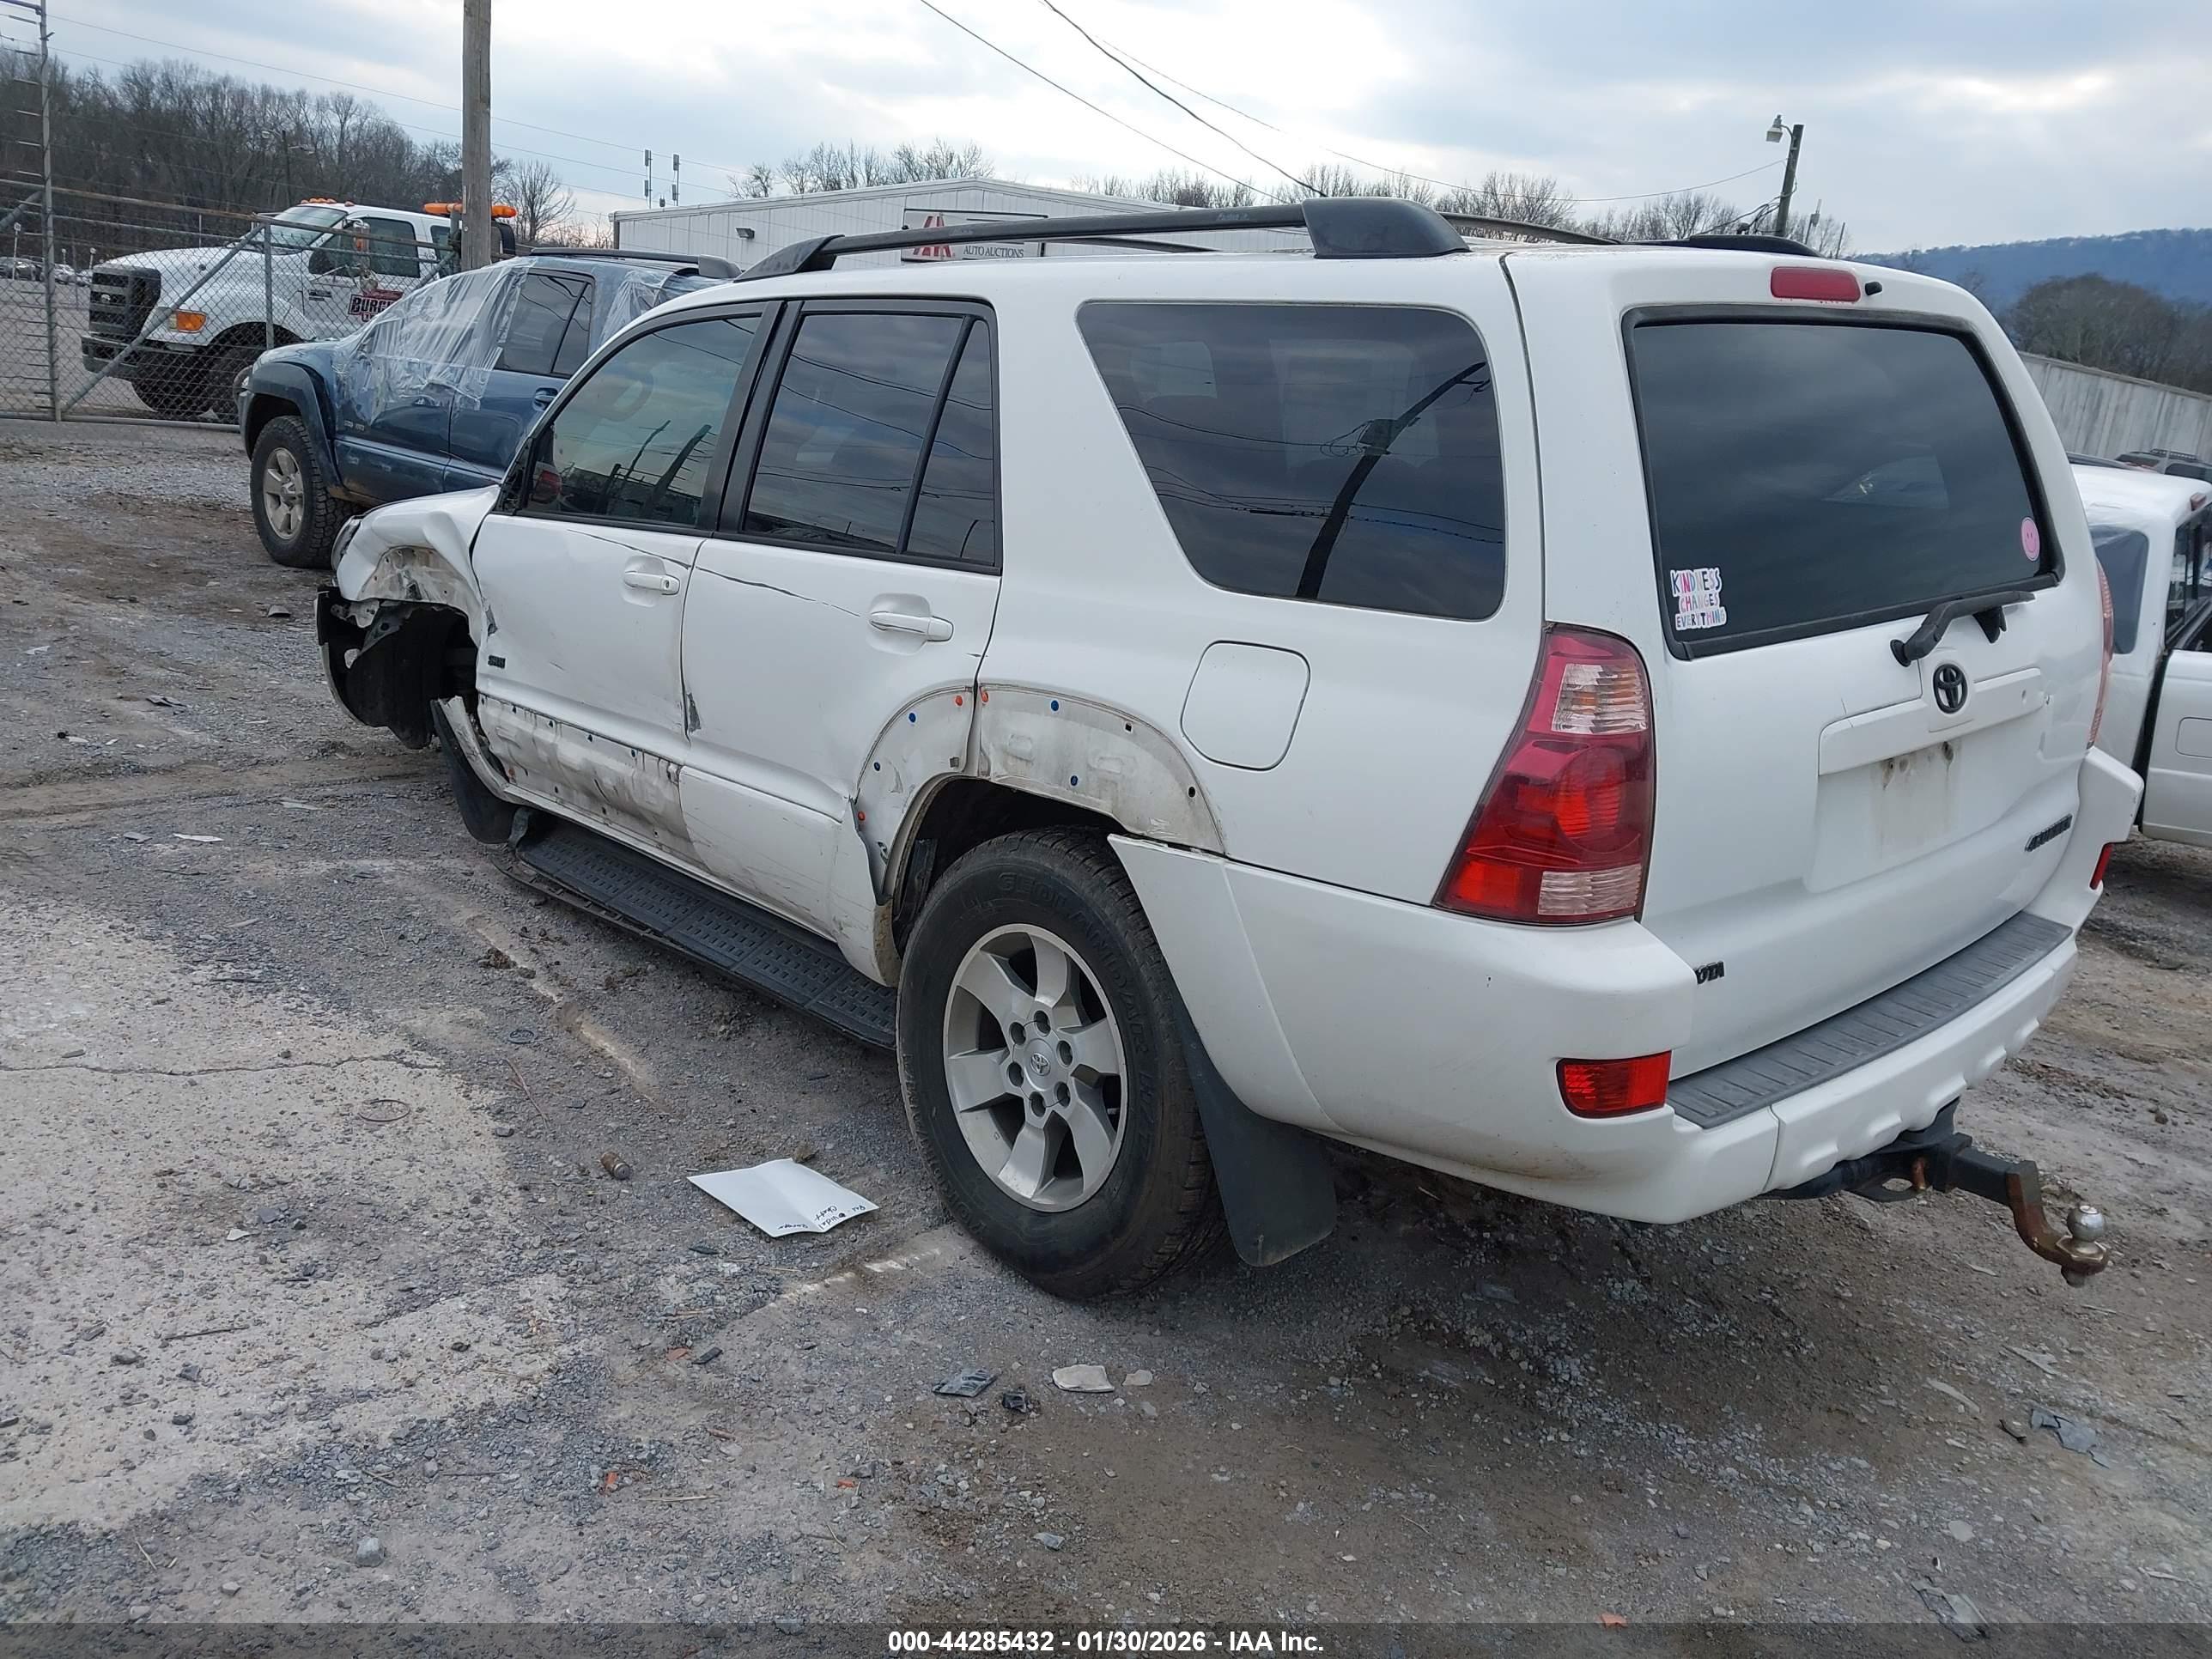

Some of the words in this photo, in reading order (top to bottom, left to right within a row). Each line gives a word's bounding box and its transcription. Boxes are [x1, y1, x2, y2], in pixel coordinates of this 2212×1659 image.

[963, 245, 985, 257] AUTO
[985, 245, 1024, 258] AUCTIONS
[1670, 569, 1720, 594] KINDNESS
[1680, 592, 1718, 612] CHANGES
[1676, 609, 1725, 628] EVERYTHING
